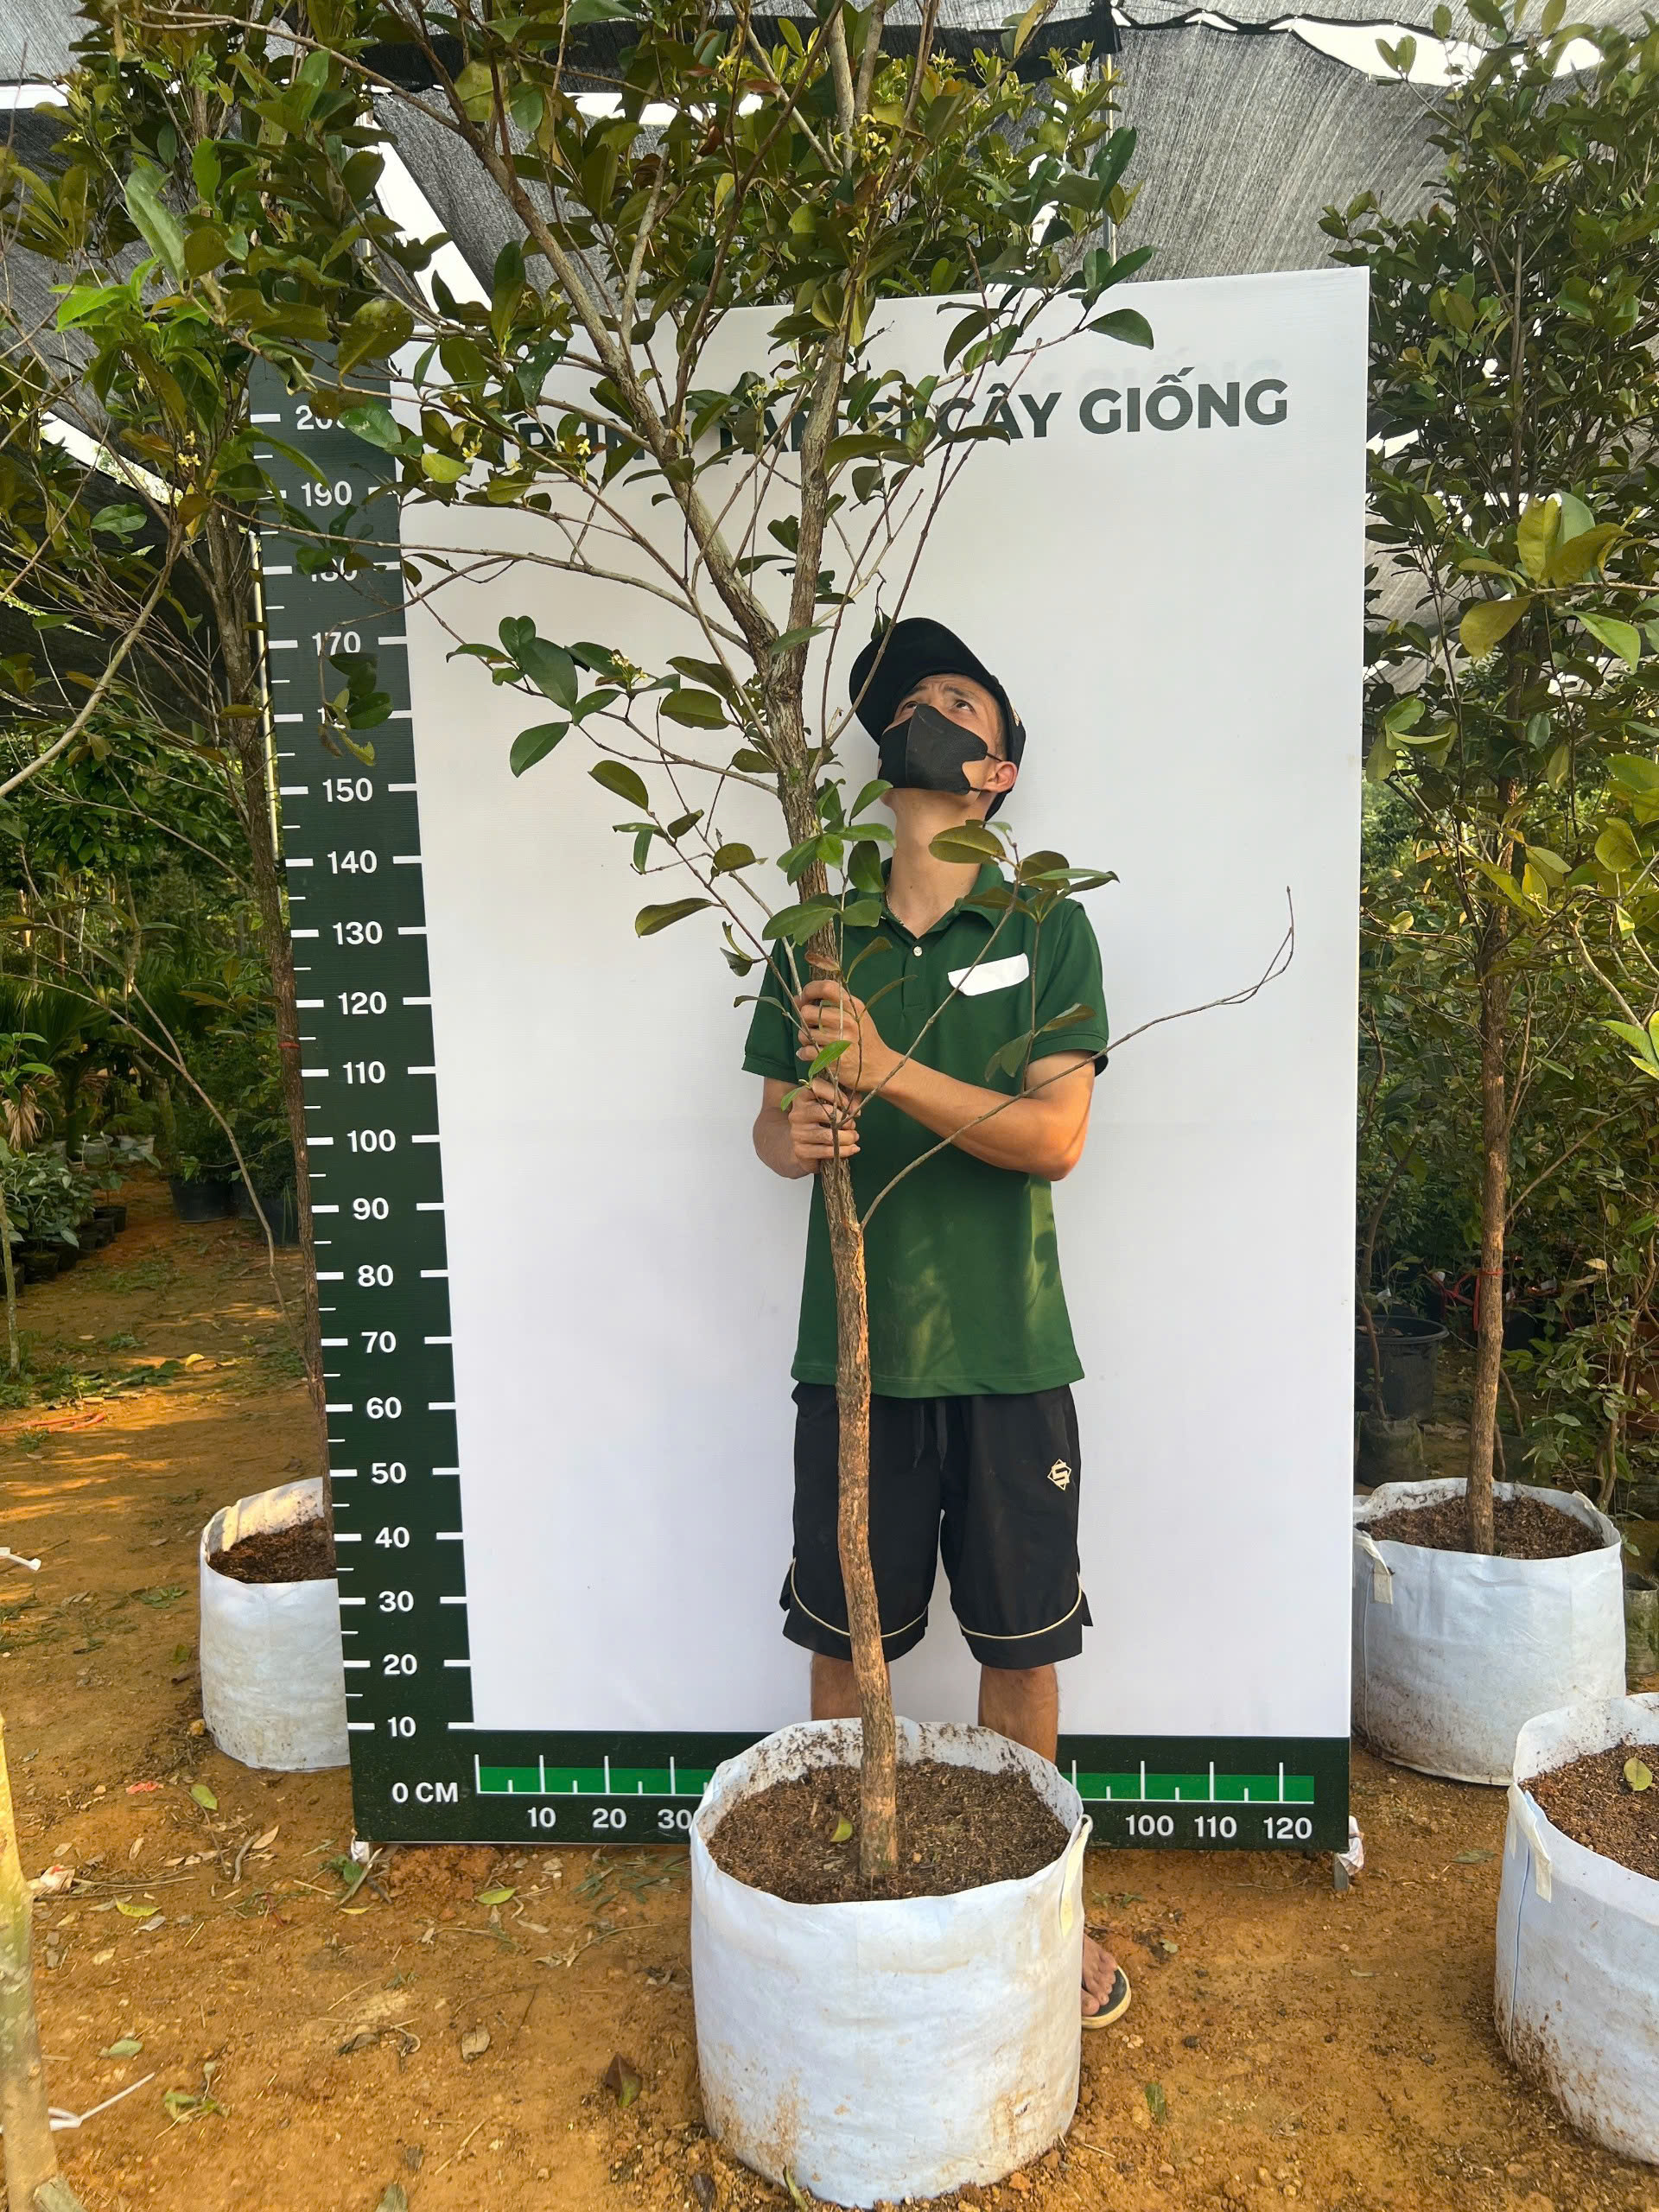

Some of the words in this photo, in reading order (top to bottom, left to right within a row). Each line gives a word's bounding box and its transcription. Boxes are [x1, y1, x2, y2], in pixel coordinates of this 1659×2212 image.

[938, 383, 1063, 443] CÂY
[1079, 366, 1288, 435] GIỐNG
[301, 480, 353, 507] 190
[312, 631, 361, 657] 170
[322, 777, 373, 803] 150
[327, 849, 378, 874] 140
[332, 920, 383, 945] 130
[338, 991, 387, 1015] 120
[342, 1060, 386, 1084] 110
[346, 1128, 397, 1153] 100
[352, 1197, 390, 1221] 90
[357, 1264, 394, 1287] 80
[360, 1331, 397, 1354] 70
[365, 1396, 402, 1420] 60
[371, 1462, 407, 1484] 50
[375, 1526, 410, 1548] 40
[378, 1590, 415, 1612] 30
[382, 1653, 418, 1675] 20
[386, 1716, 416, 1738] 10
[391, 1782, 409, 1803] 0
[415, 1782, 459, 1803] CM
[527, 1807, 556, 1827] 10
[592, 1808, 626, 1828] 20
[658, 1808, 692, 1829] 30
[1125, 1815, 1174, 1836] 100
[1194, 1815, 1237, 1838] 110
[1263, 1816, 1313, 1840] 120
